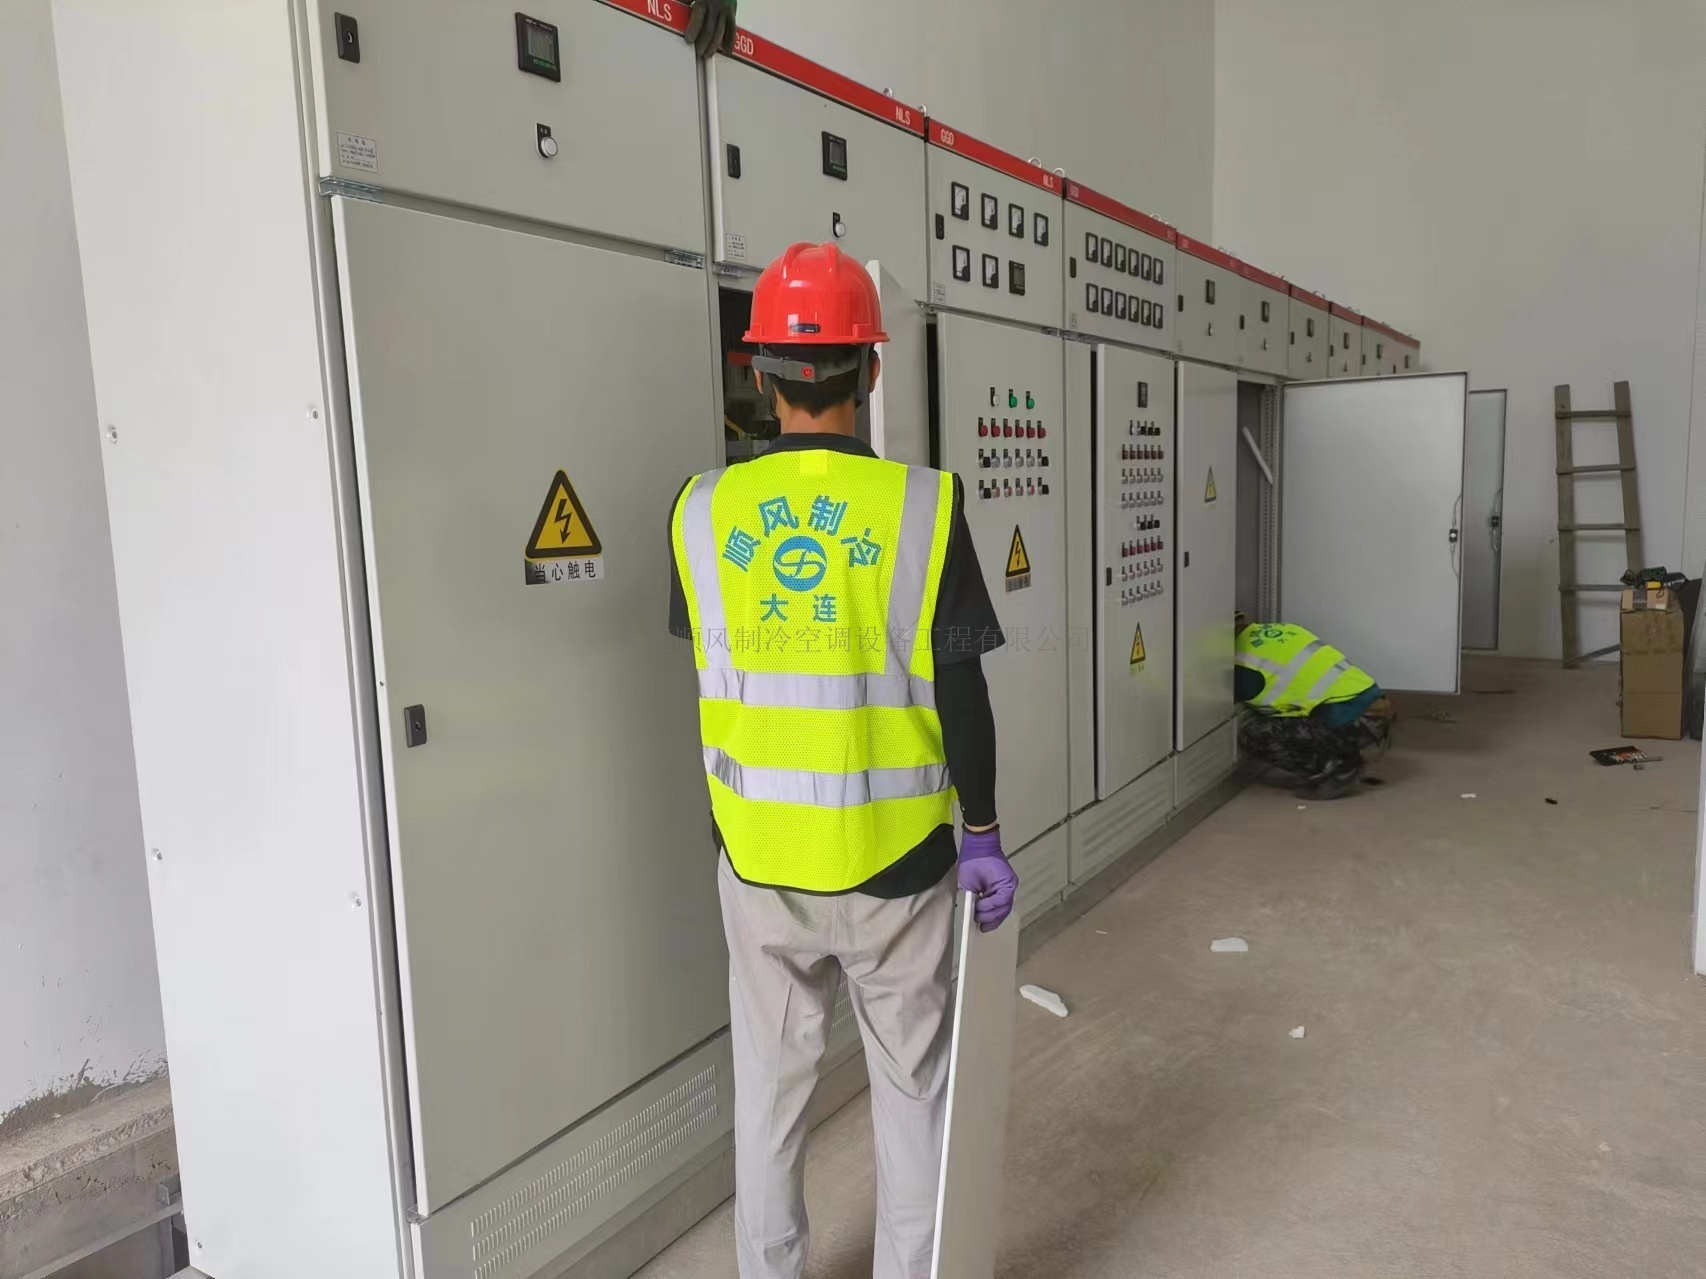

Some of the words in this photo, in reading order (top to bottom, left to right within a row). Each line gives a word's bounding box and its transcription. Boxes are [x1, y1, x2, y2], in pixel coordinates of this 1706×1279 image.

[647, 0, 672, 21] NLS
[895, 106, 911, 125] NLS
[940, 129, 954, 146] GGD
[722, 495, 883, 572] 顺风制冷
[535, 559, 597, 584] 当心触电
